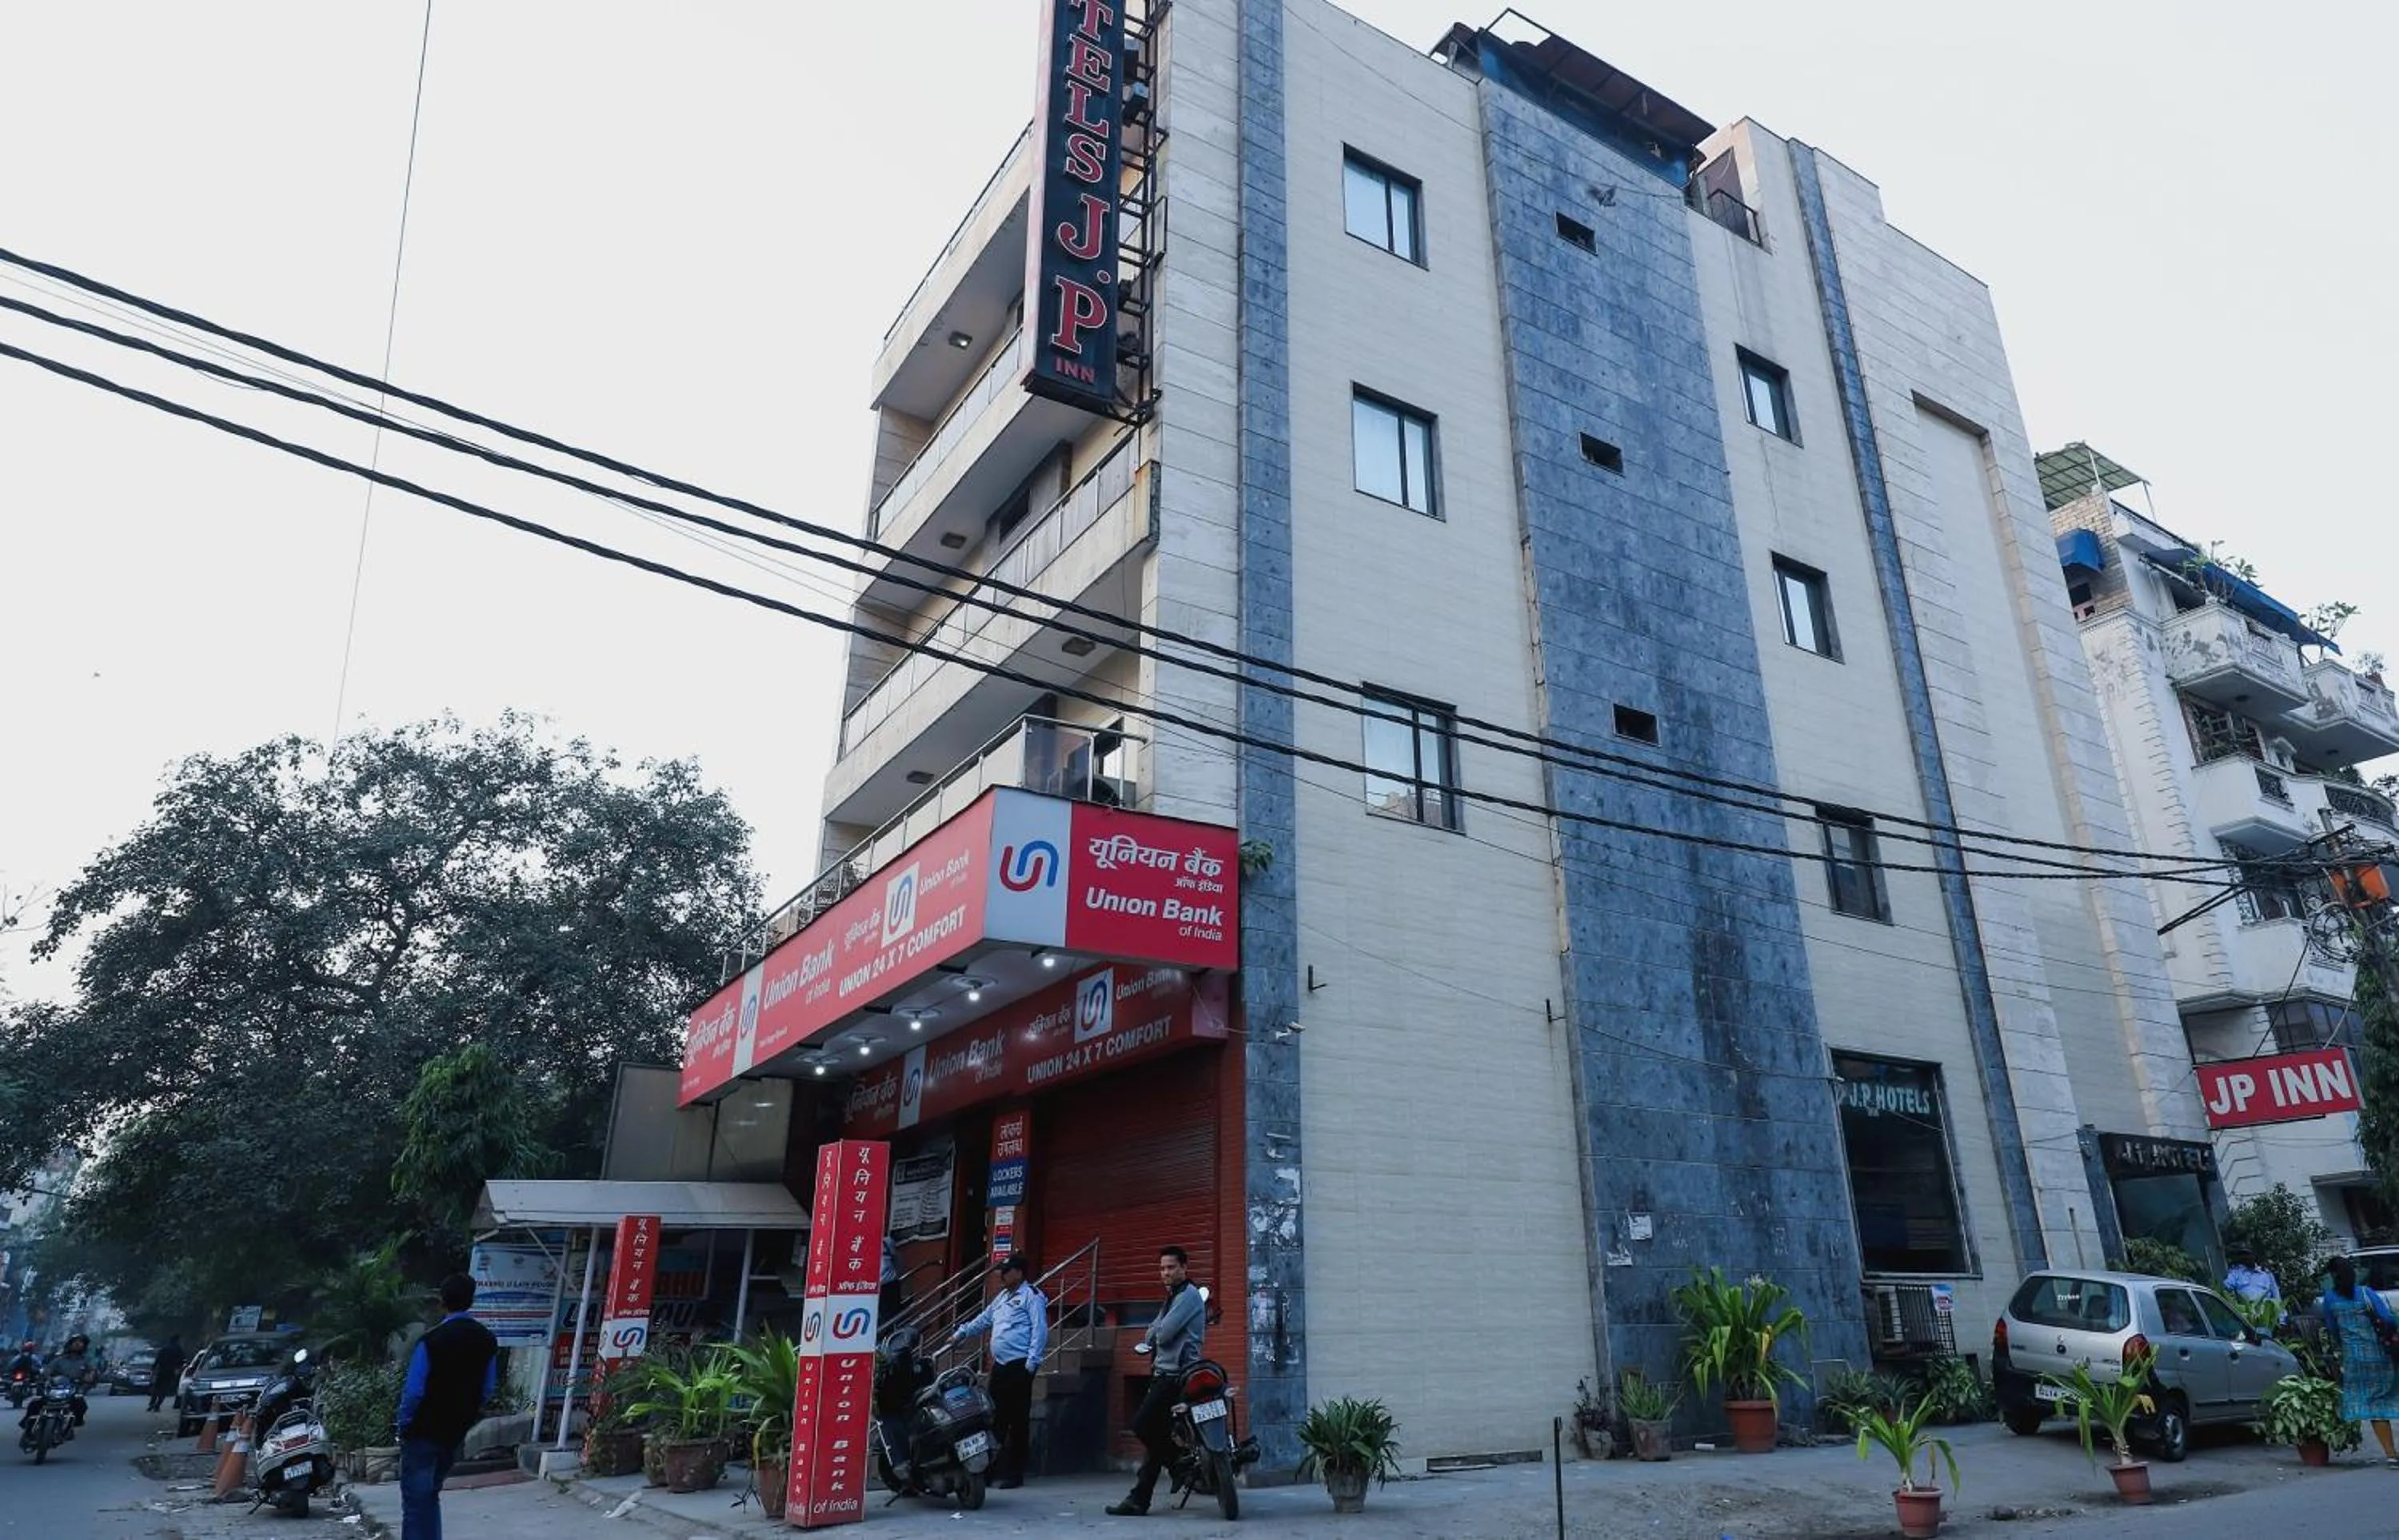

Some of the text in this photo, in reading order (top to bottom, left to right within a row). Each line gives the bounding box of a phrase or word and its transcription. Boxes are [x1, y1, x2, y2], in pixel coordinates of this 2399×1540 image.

[1056, 357, 1096, 383] INN
[1088, 835, 1223, 876] यूनियन बैंक
[1086, 887, 1224, 926] Union Bank
[840, 905, 967, 998] UNION 24 X 7 COMFORT
[1179, 926, 1222, 941] of India
[764, 938, 835, 1011] Union Bank
[928, 1029, 1006, 1082] Union Bank
[1028, 1015, 1172, 1083] UNION 24 X 7 COMFORT
[1875, 1085, 1930, 1114] HOTELS
[2209, 1059, 2353, 1115] JP INN
[831, 1358, 858, 1491] Union Bank
[813, 1498, 859, 1514] of India
